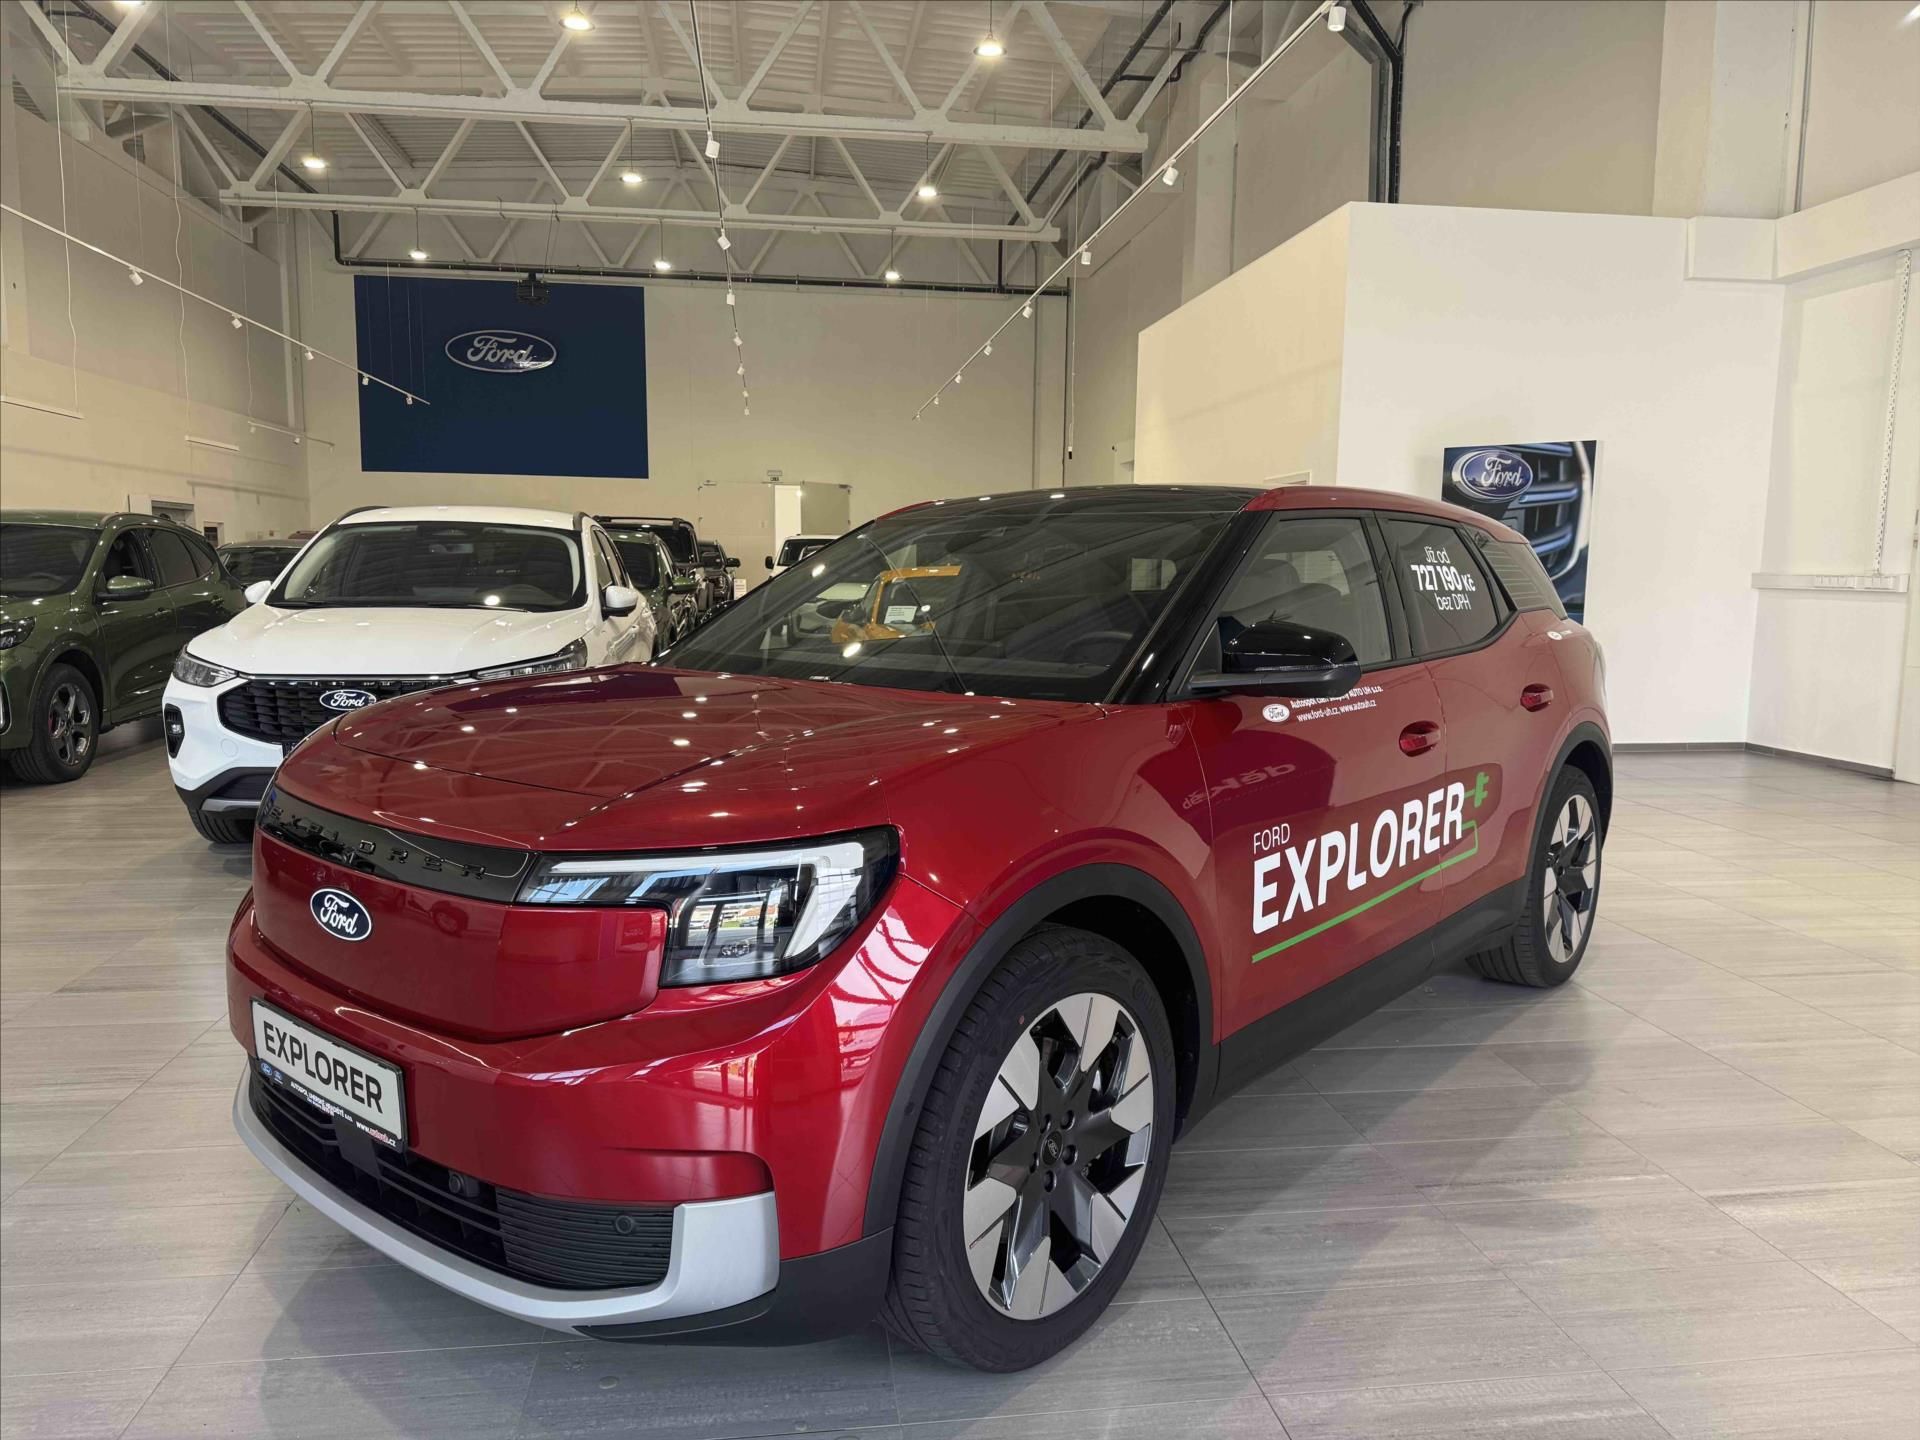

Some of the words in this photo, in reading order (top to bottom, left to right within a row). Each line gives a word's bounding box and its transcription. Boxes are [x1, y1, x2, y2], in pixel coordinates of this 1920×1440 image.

[467, 335, 534, 362] Ford
[1481, 456, 1523, 487] Ford
[1436, 547, 1450, 564] od
[1410, 565, 1438, 591] 727
[1436, 565, 1462, 591] 190
[1461, 574, 1476, 591] Kč
[1434, 592, 1454, 610] bez
[1452, 593, 1471, 610] DPH
[331, 692, 366, 707] Ford
[1253, 823, 1290, 854] FORD
[1253, 782, 1465, 935] EXPLORER
[320, 893, 359, 935] Ford
[263, 1020, 383, 1114] EXPLORER
